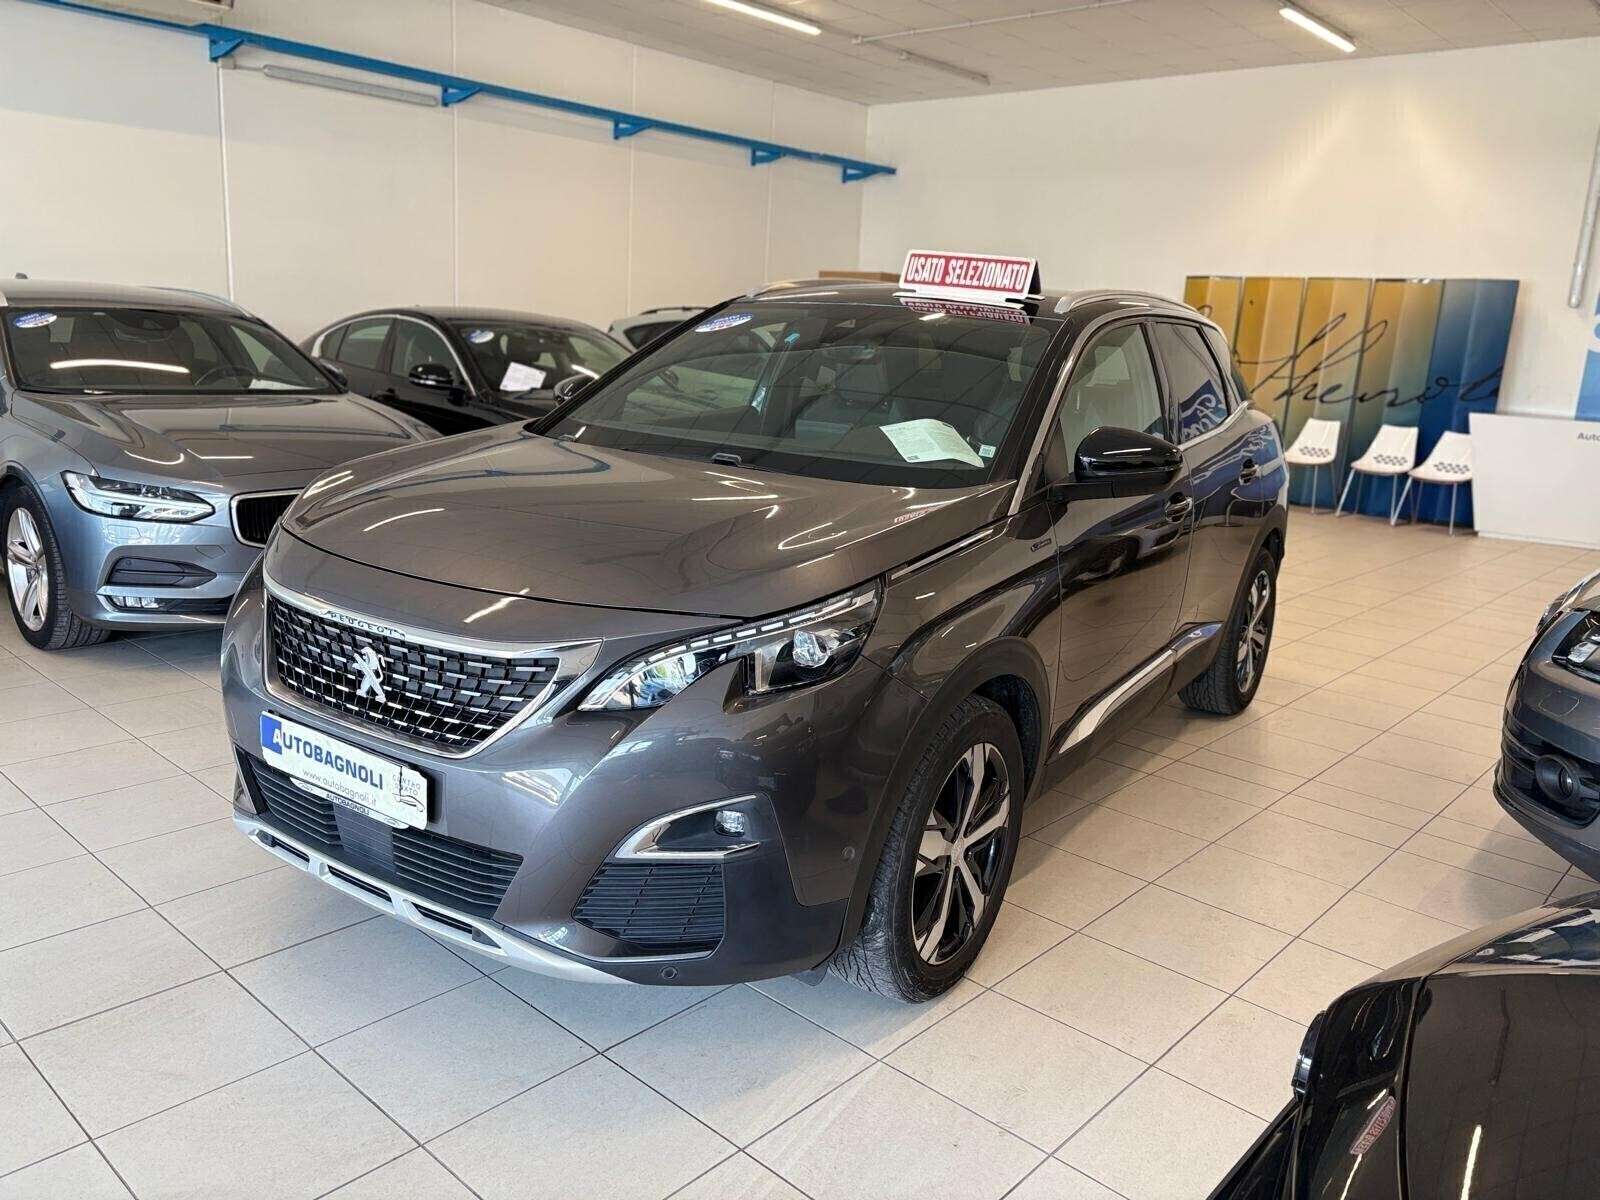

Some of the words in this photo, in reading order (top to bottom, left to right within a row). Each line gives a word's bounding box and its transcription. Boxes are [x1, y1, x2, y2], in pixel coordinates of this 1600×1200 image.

[906, 256, 945, 283] USATO
[945, 258, 1028, 290] SELEZIONATO
[330, 612, 395, 636] PEUGEOT
[272, 728, 383, 790] AUTOBAGNOLI
[302, 769, 377, 806] www.autobagnoli.it
[325, 793, 370, 816] AUTOBAGNOLI
